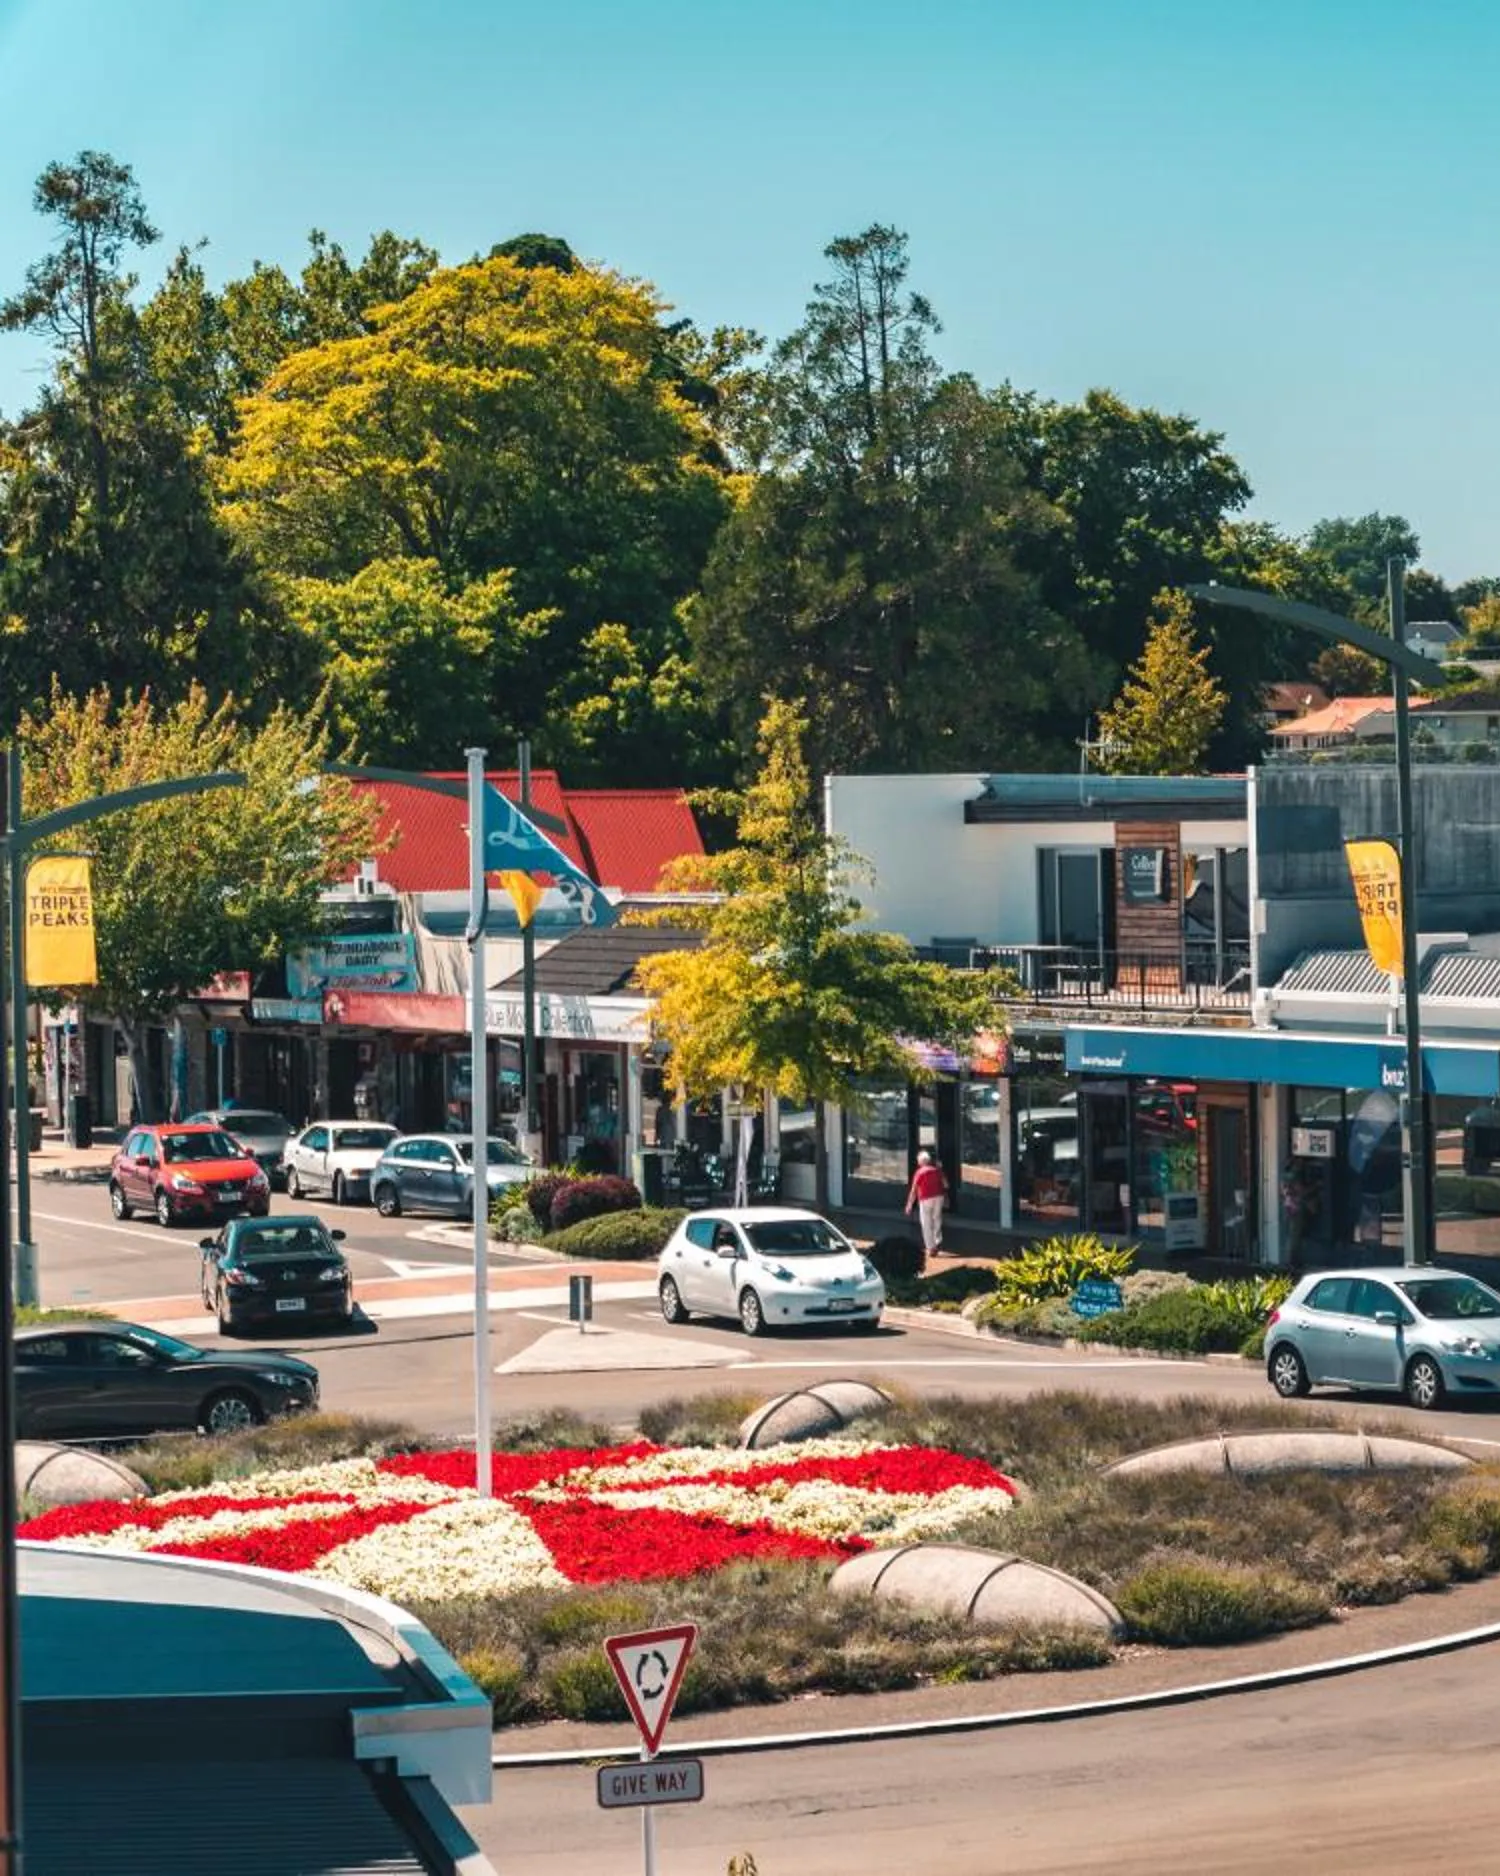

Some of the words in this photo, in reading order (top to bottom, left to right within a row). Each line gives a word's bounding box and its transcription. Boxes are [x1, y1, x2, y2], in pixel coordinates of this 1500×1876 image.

[30, 896, 89, 910] TRIPLE
[30, 912, 89, 926] PEAKS
[1382, 1063, 1405, 1087] bnz
[612, 1774, 648, 1797] GIVE
[655, 1772, 687, 1793] WAY
